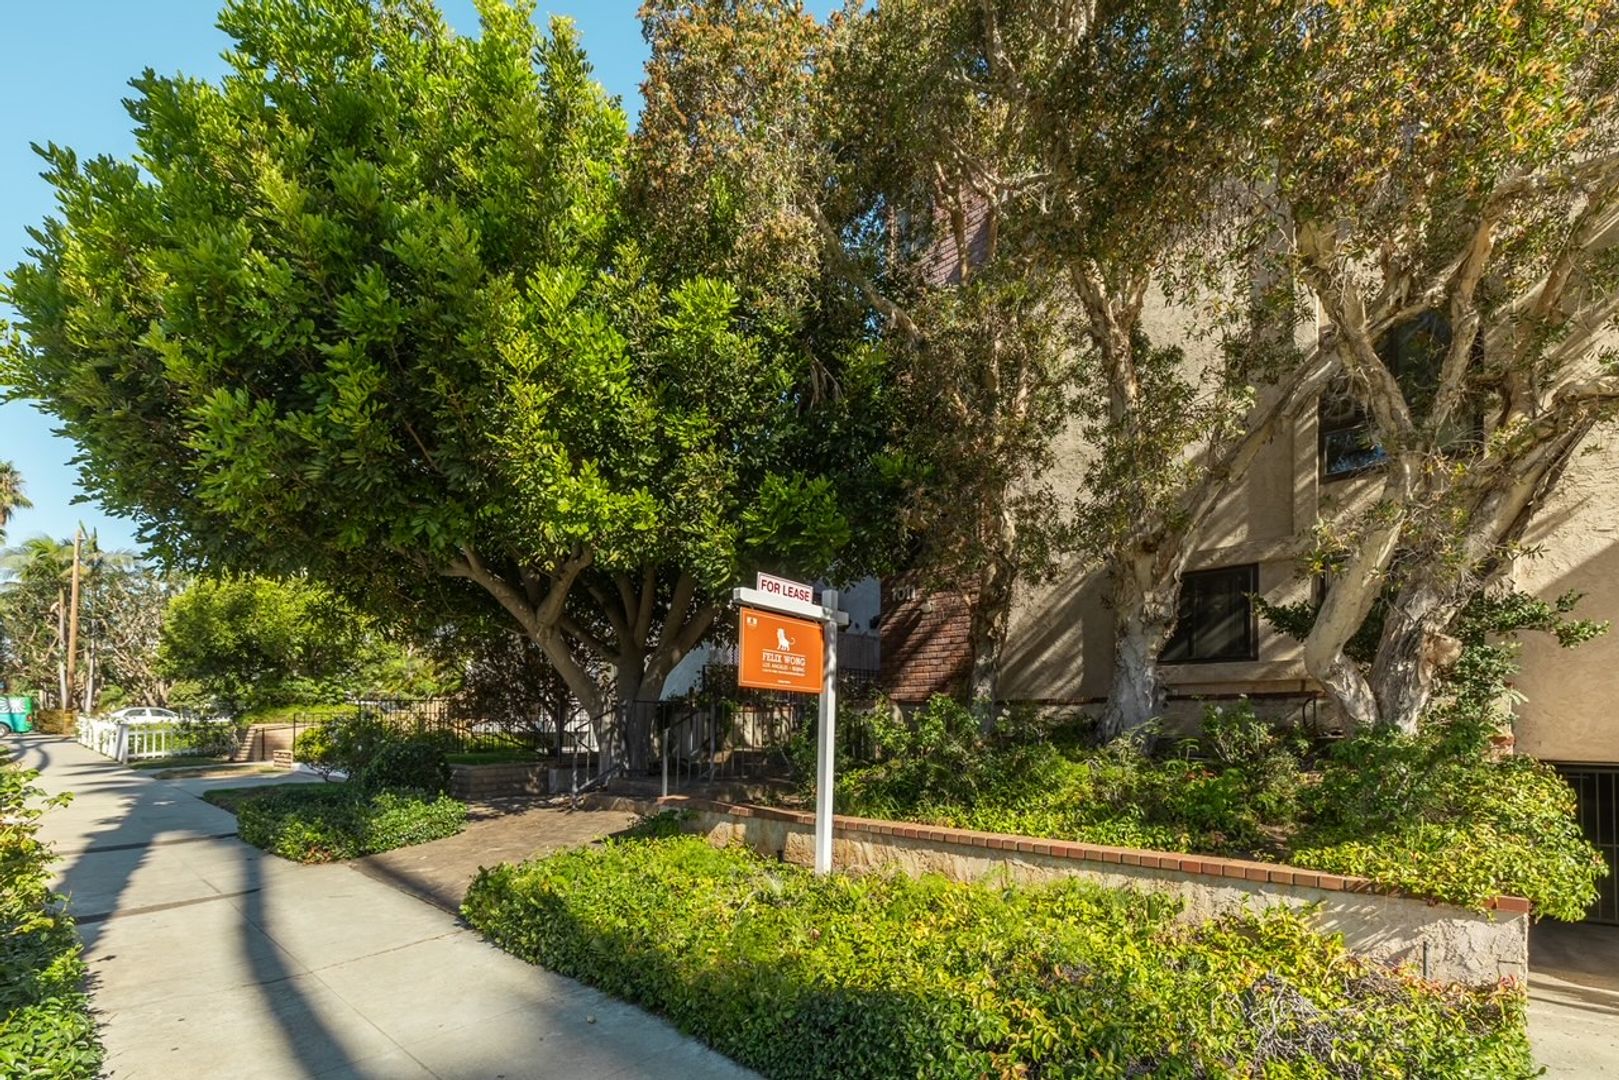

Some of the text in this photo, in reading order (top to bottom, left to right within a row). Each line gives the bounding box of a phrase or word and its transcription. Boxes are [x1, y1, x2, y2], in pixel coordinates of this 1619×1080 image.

[761, 579, 810, 602] FOR LEASE
[762, 652, 806, 667] FELIX WONG
